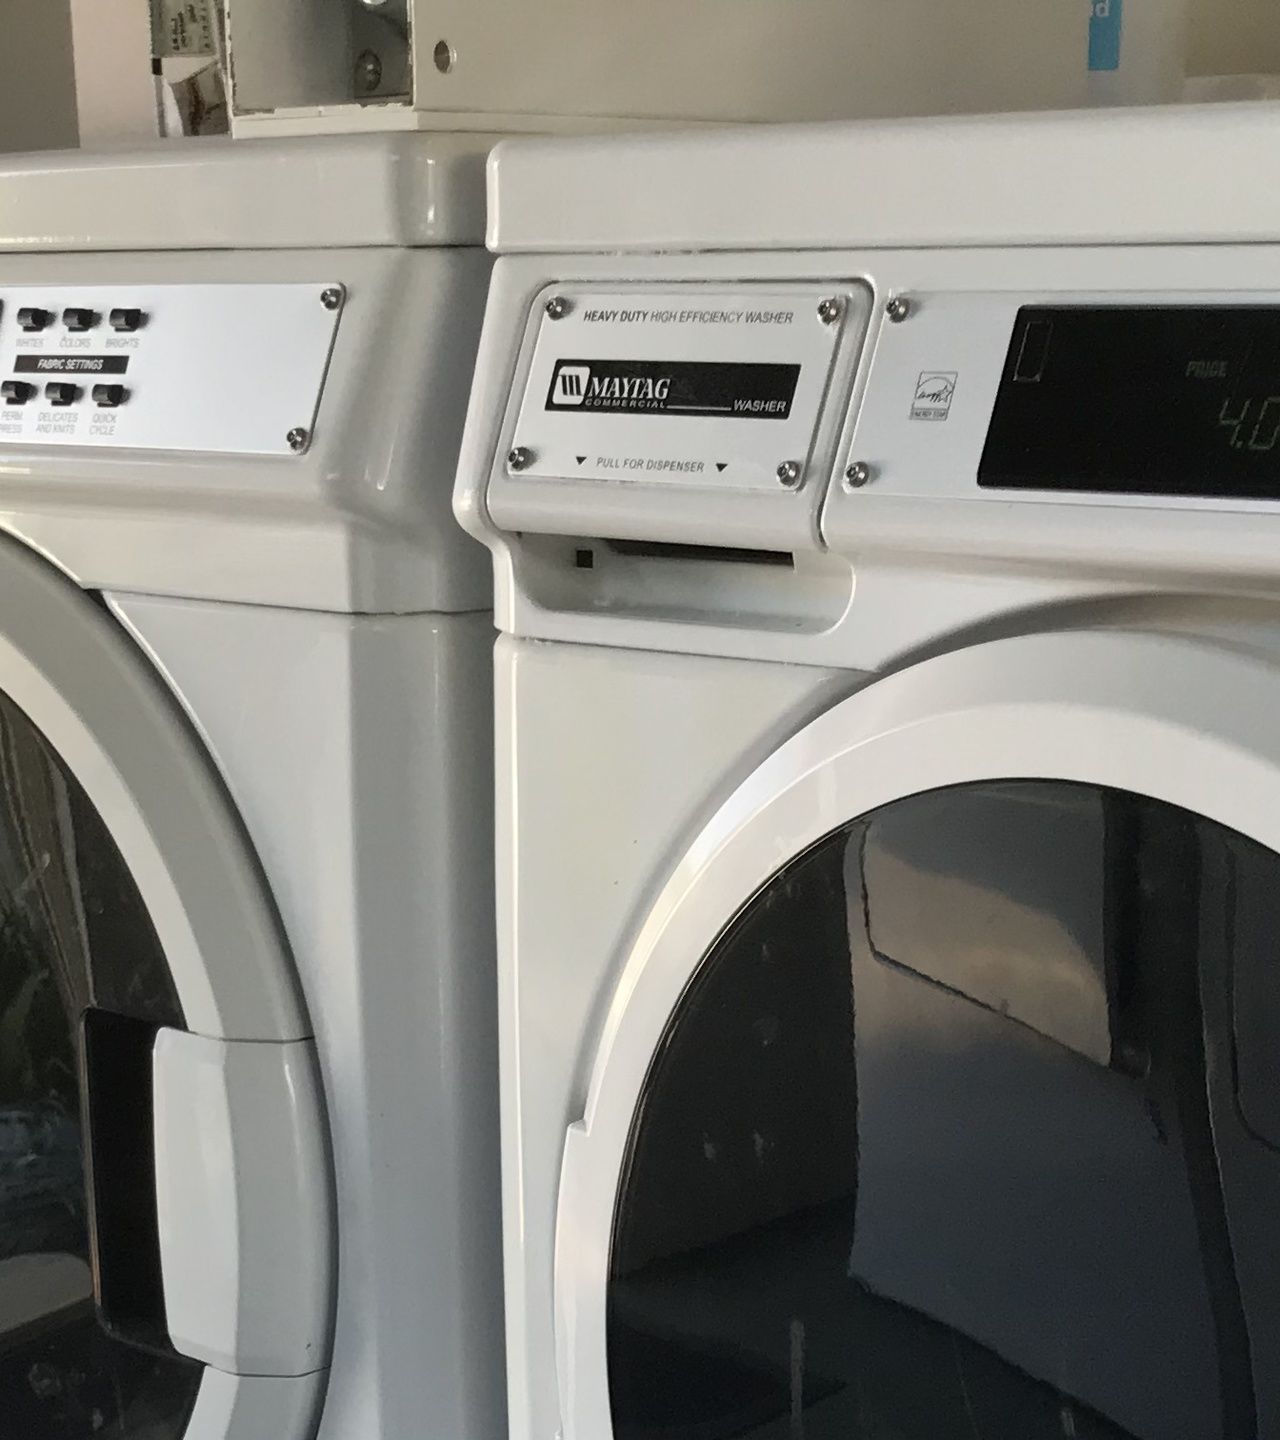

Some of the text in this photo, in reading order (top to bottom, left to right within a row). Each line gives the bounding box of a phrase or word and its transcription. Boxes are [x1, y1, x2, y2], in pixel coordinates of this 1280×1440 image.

[583, 310, 793, 324] HEAVY DUTY HIGH EFFICIENCY WASHER
[37, 359, 104, 370] FABRIC SETTINGS
[588, 377, 670, 400] MAYTAG
[585, 399, 787, 412] COMMERCIAL WASHER
[596, 456, 705, 472] PULL FOR DISPENSER
